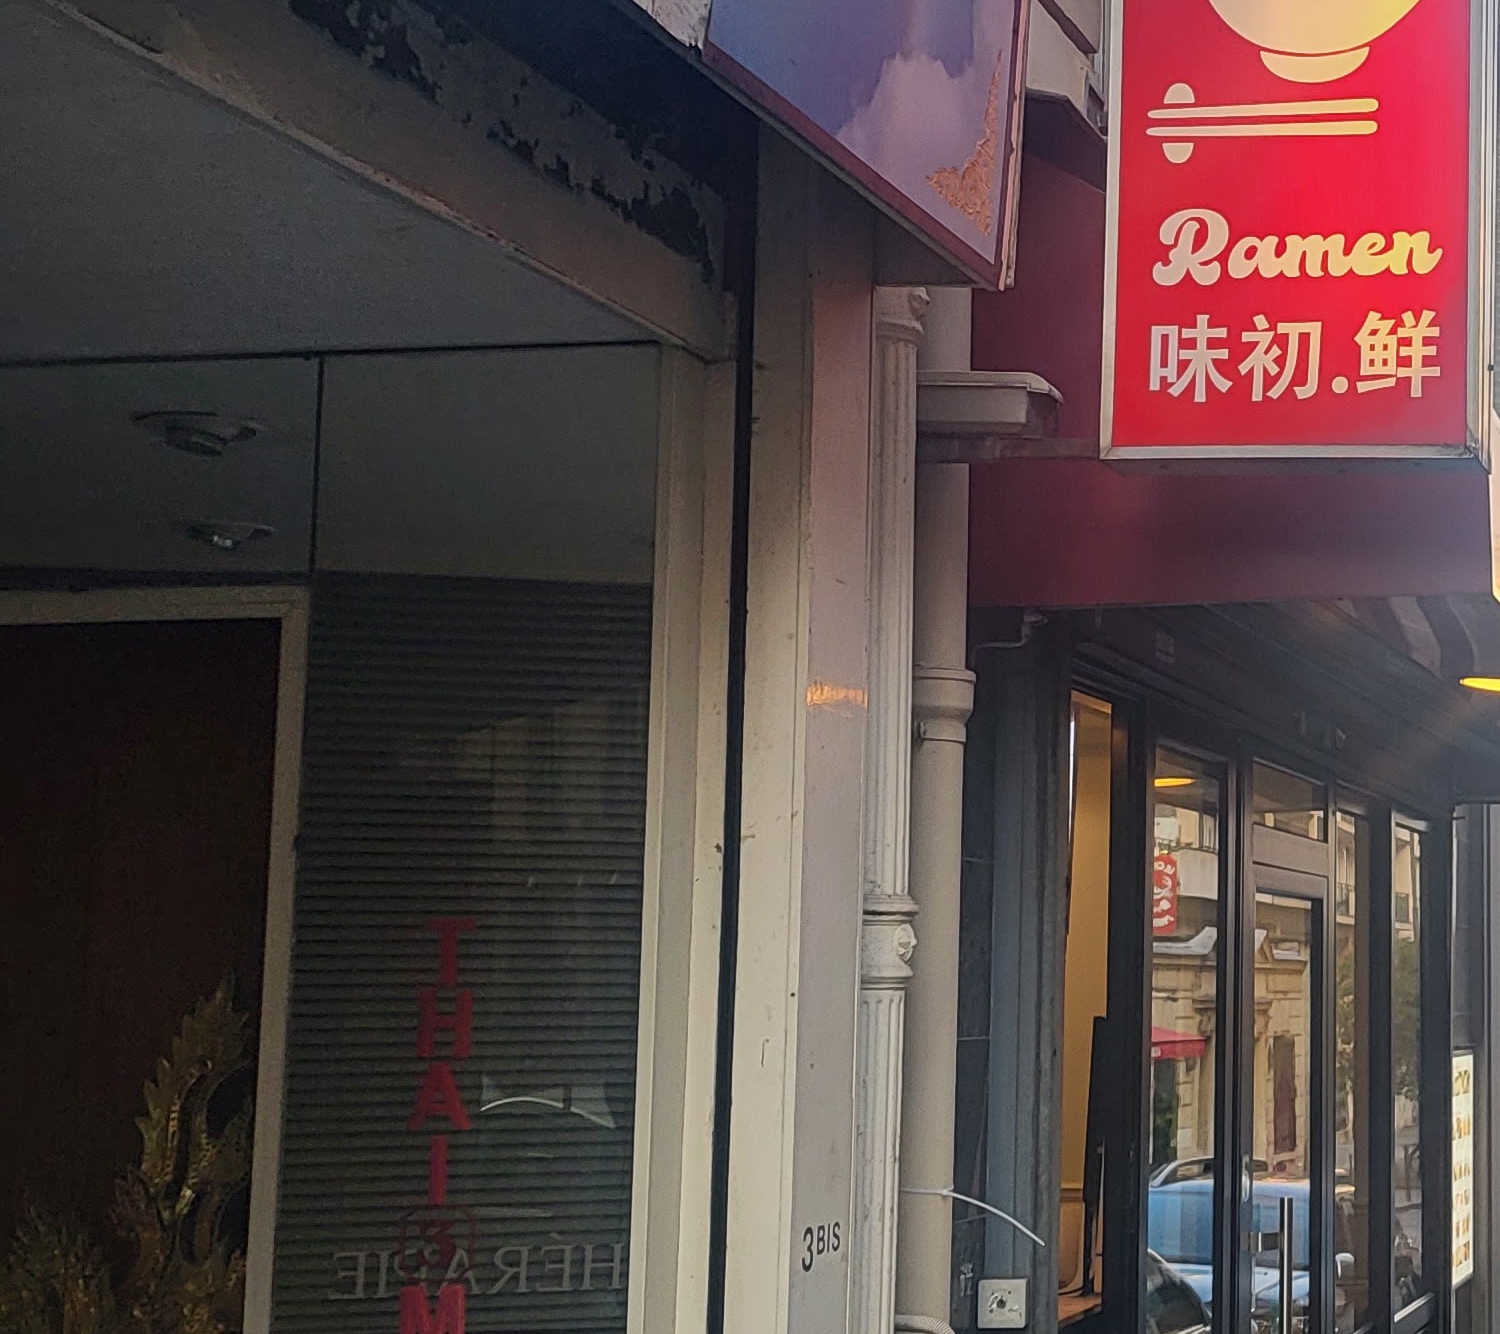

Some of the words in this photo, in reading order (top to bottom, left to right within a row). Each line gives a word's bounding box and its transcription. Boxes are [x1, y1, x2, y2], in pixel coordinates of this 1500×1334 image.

[1152, 208, 1443, 286] Ramen
[1148, 309, 1441, 403] 味初.鲜
[415, 917, 476, 1205] THAI
